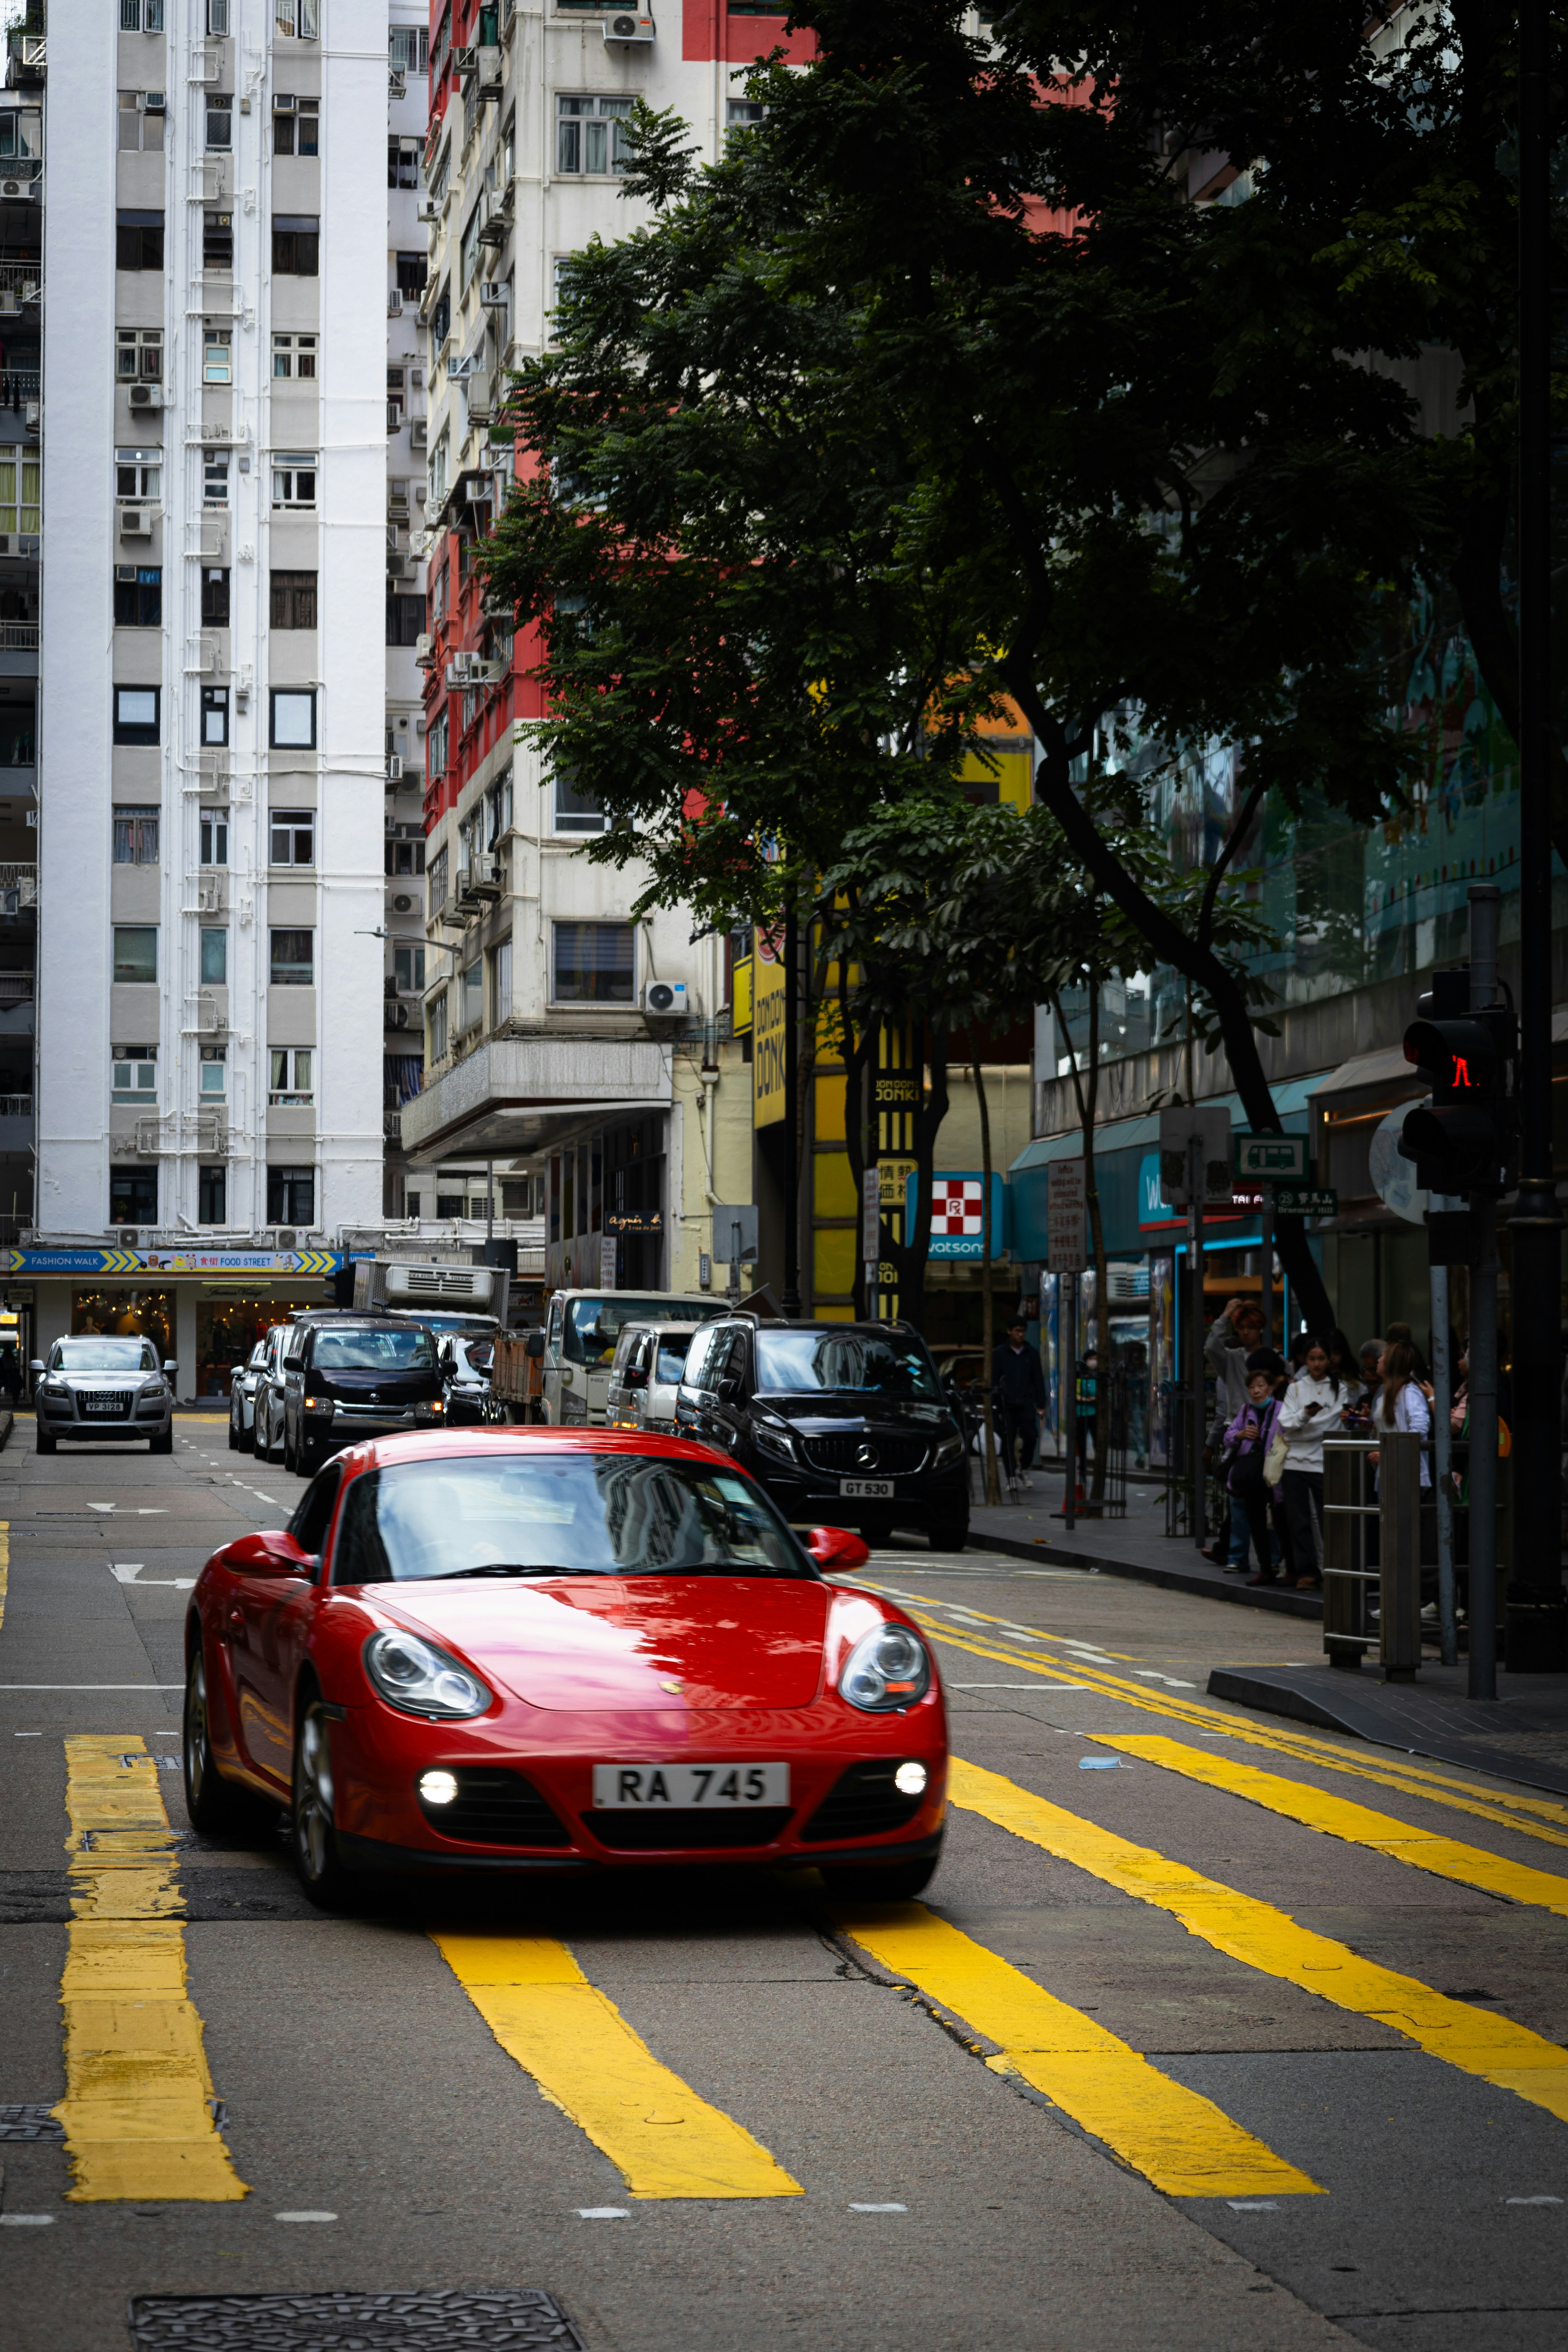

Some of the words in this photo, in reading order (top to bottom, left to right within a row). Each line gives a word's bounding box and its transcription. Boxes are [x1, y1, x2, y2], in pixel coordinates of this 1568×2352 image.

[757, 1031, 786, 1099] DONK
[1232, 1194, 1250, 1204] TAI
[74, 1257, 98, 1265] WALK
[200, 1257, 218, 1266] 食街
[220, 1258, 241, 1266] FOOD
[243, 1258, 271, 1266] STREET
[846, 1483, 862, 1494] GT
[865, 1483, 888, 1495] 530
[617, 1770, 672, 1802] RA
[690, 1769, 766, 1802] 745
